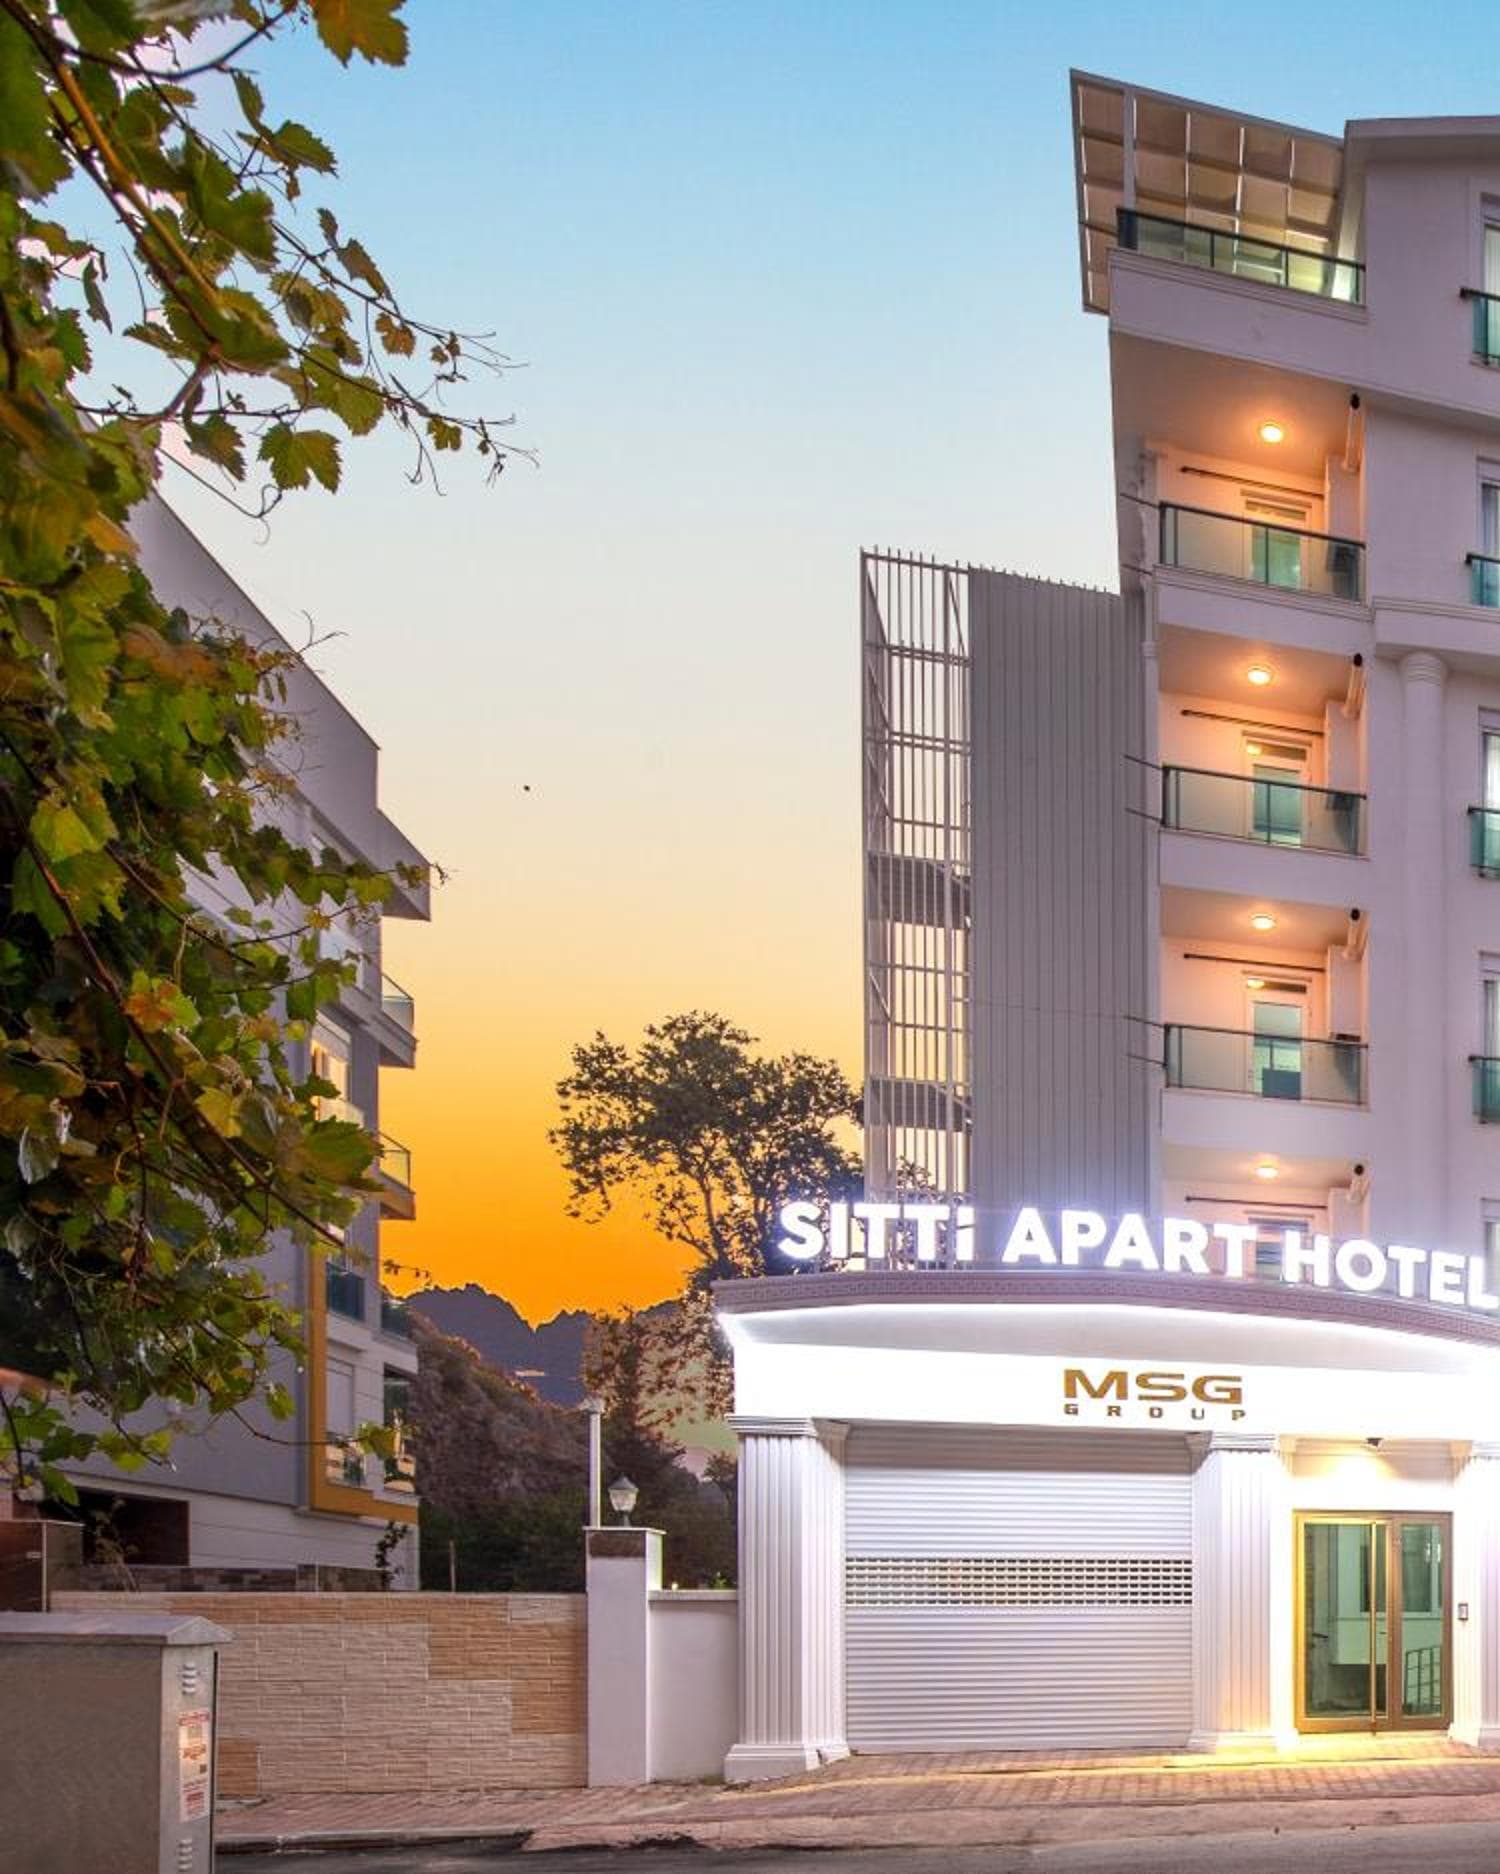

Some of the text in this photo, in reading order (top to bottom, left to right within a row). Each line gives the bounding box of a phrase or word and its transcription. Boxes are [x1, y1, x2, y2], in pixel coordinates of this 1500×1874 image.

[1001, 1207, 1257, 1278] APART
[1284, 1230, 1500, 1309] HOTEL
[1064, 1369, 1242, 1404] MSG
[1064, 1403, 1246, 1421] GROUP
